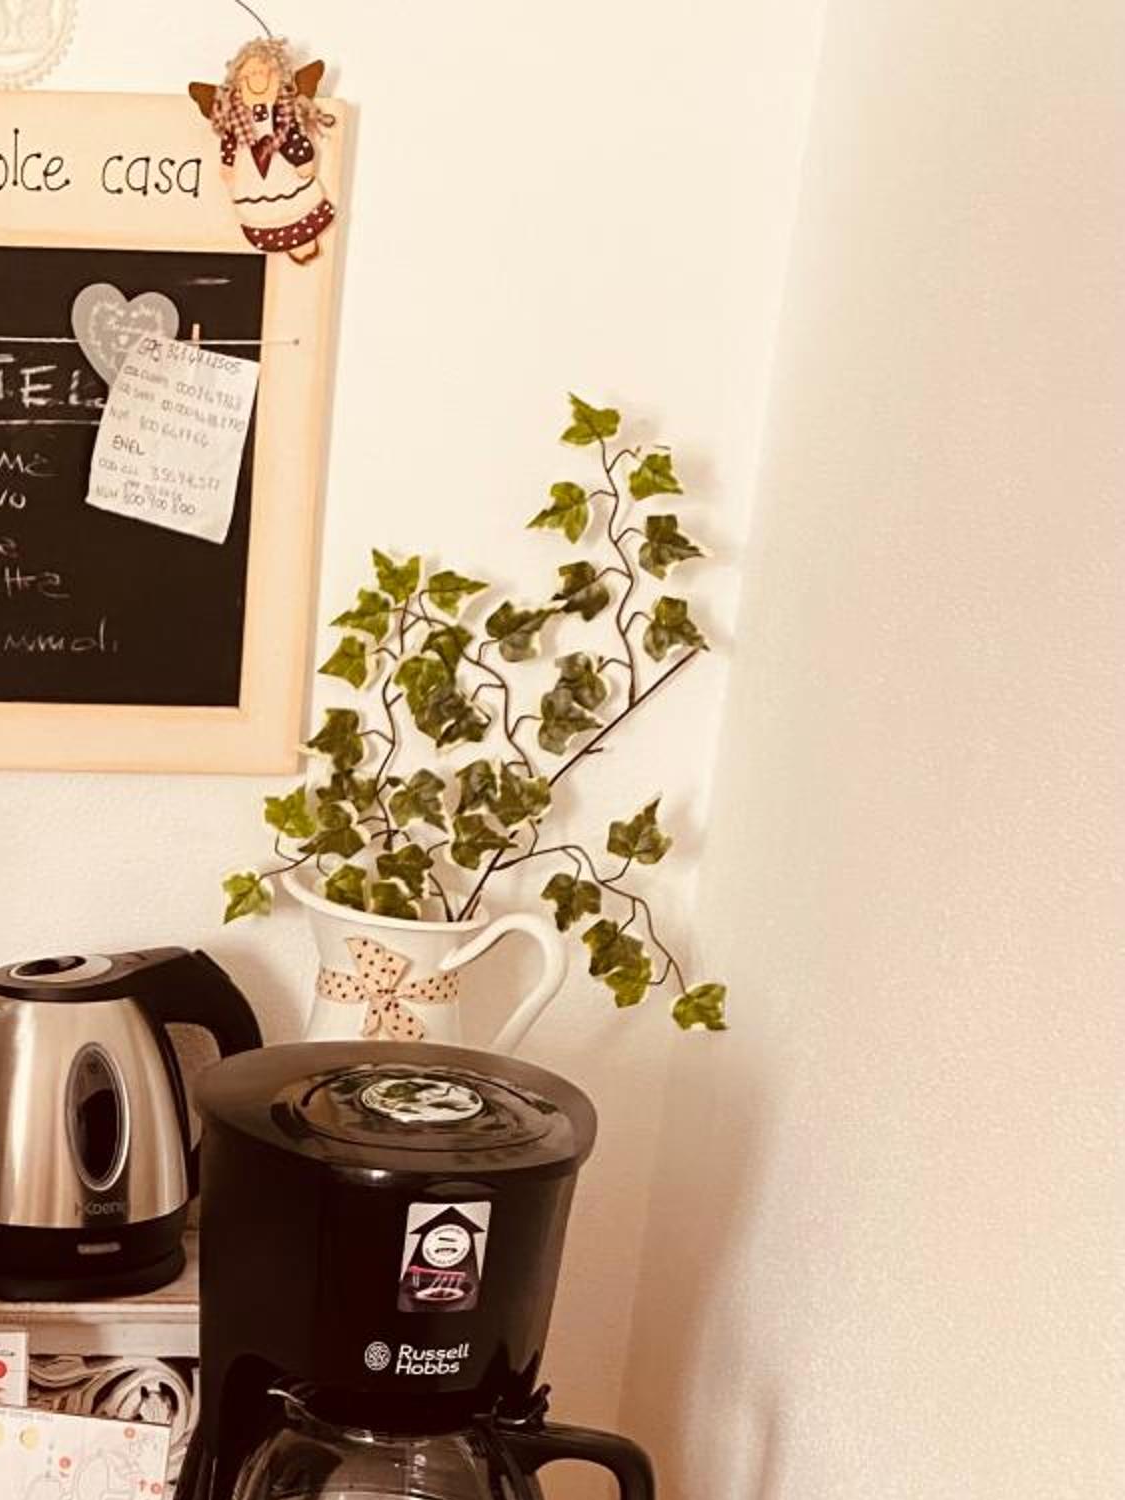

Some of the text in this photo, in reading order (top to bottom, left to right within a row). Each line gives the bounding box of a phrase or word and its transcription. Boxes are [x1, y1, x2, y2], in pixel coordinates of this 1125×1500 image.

[100, 154, 203, 199] casa
[397, 1342, 470, 1362] Russell
[394, 1358, 461, 1375] Hobbs
